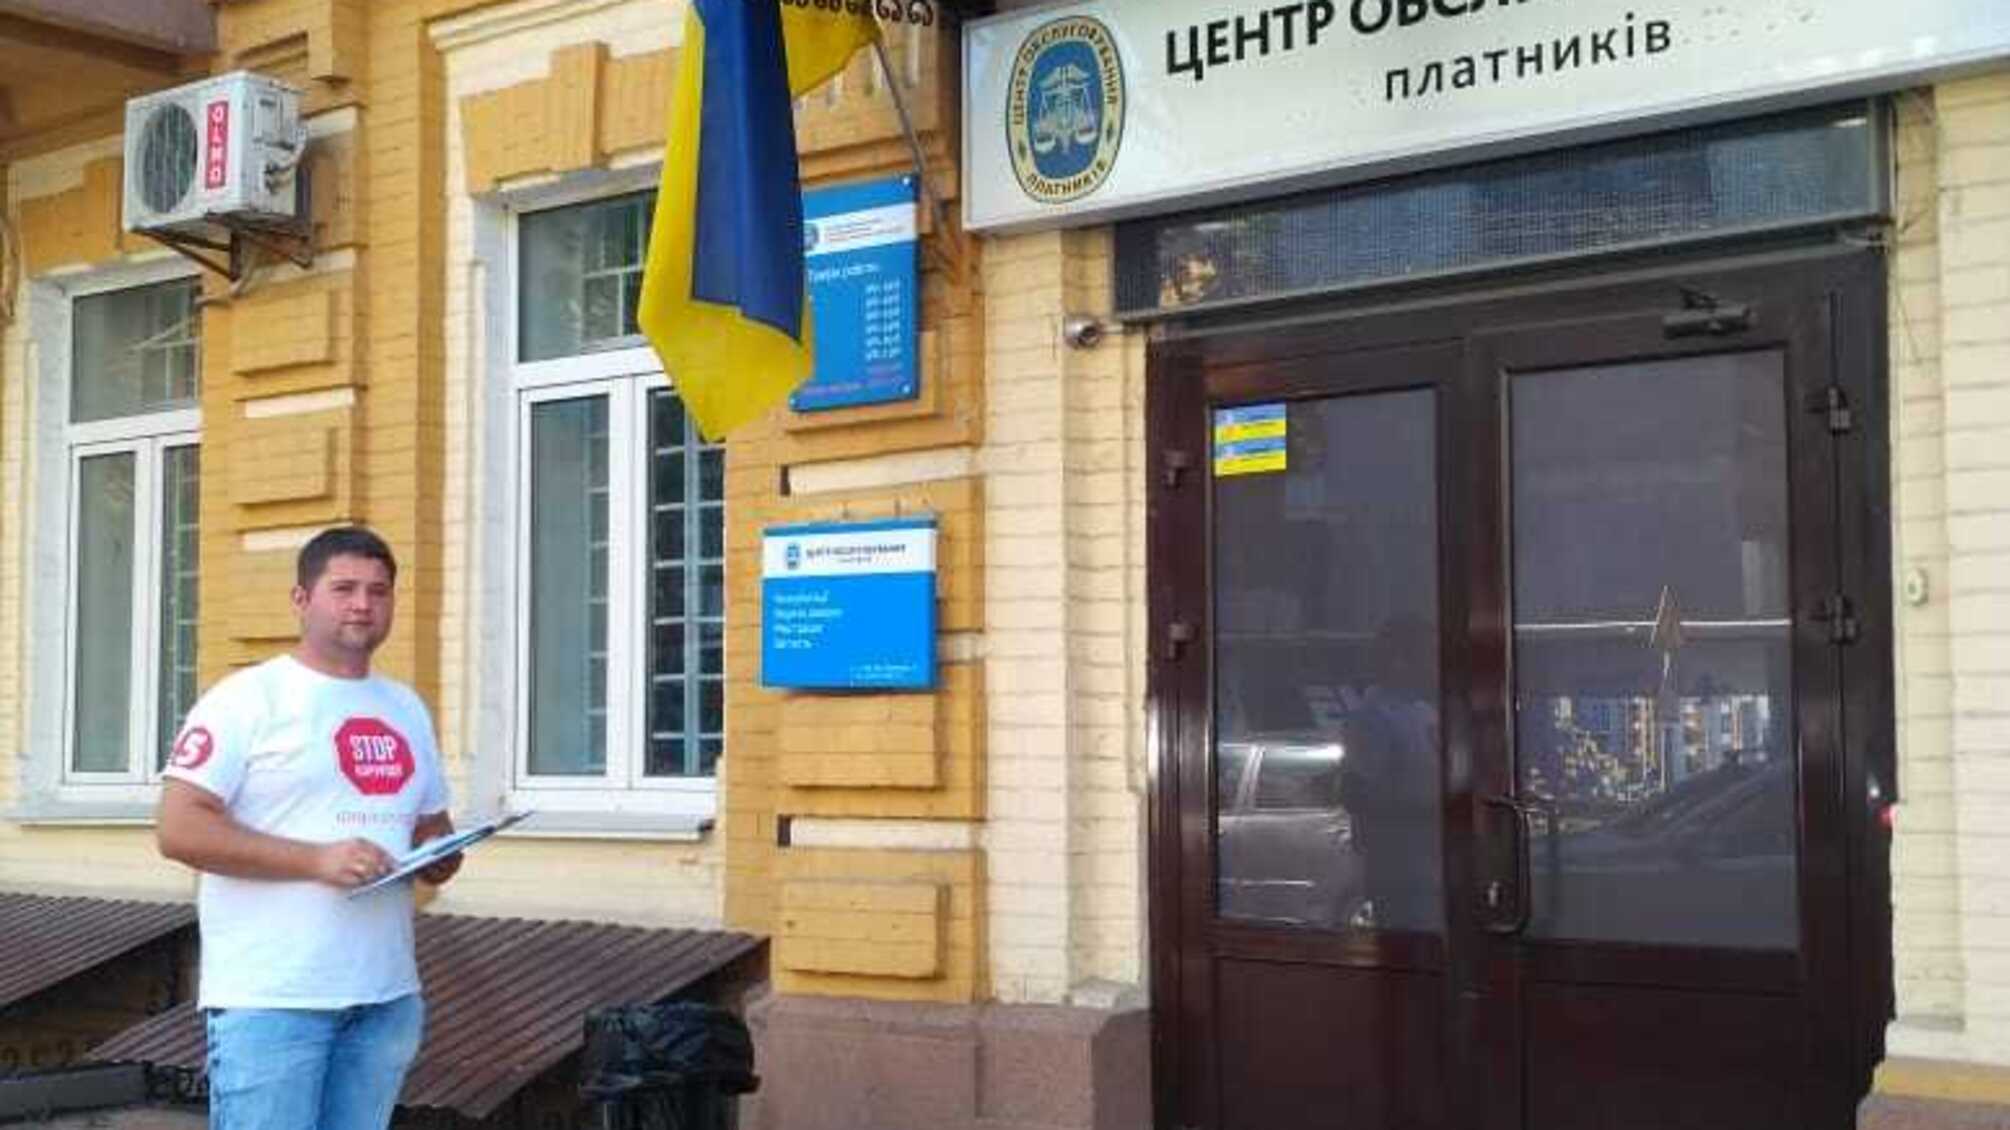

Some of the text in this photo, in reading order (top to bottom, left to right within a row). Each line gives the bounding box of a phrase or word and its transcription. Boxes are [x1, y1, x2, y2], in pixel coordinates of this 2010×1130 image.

[1167, 0, 1334, 81] ЦЕНТР
[1385, 11, 1672, 101] платників
[349, 734, 398, 761] STOP
